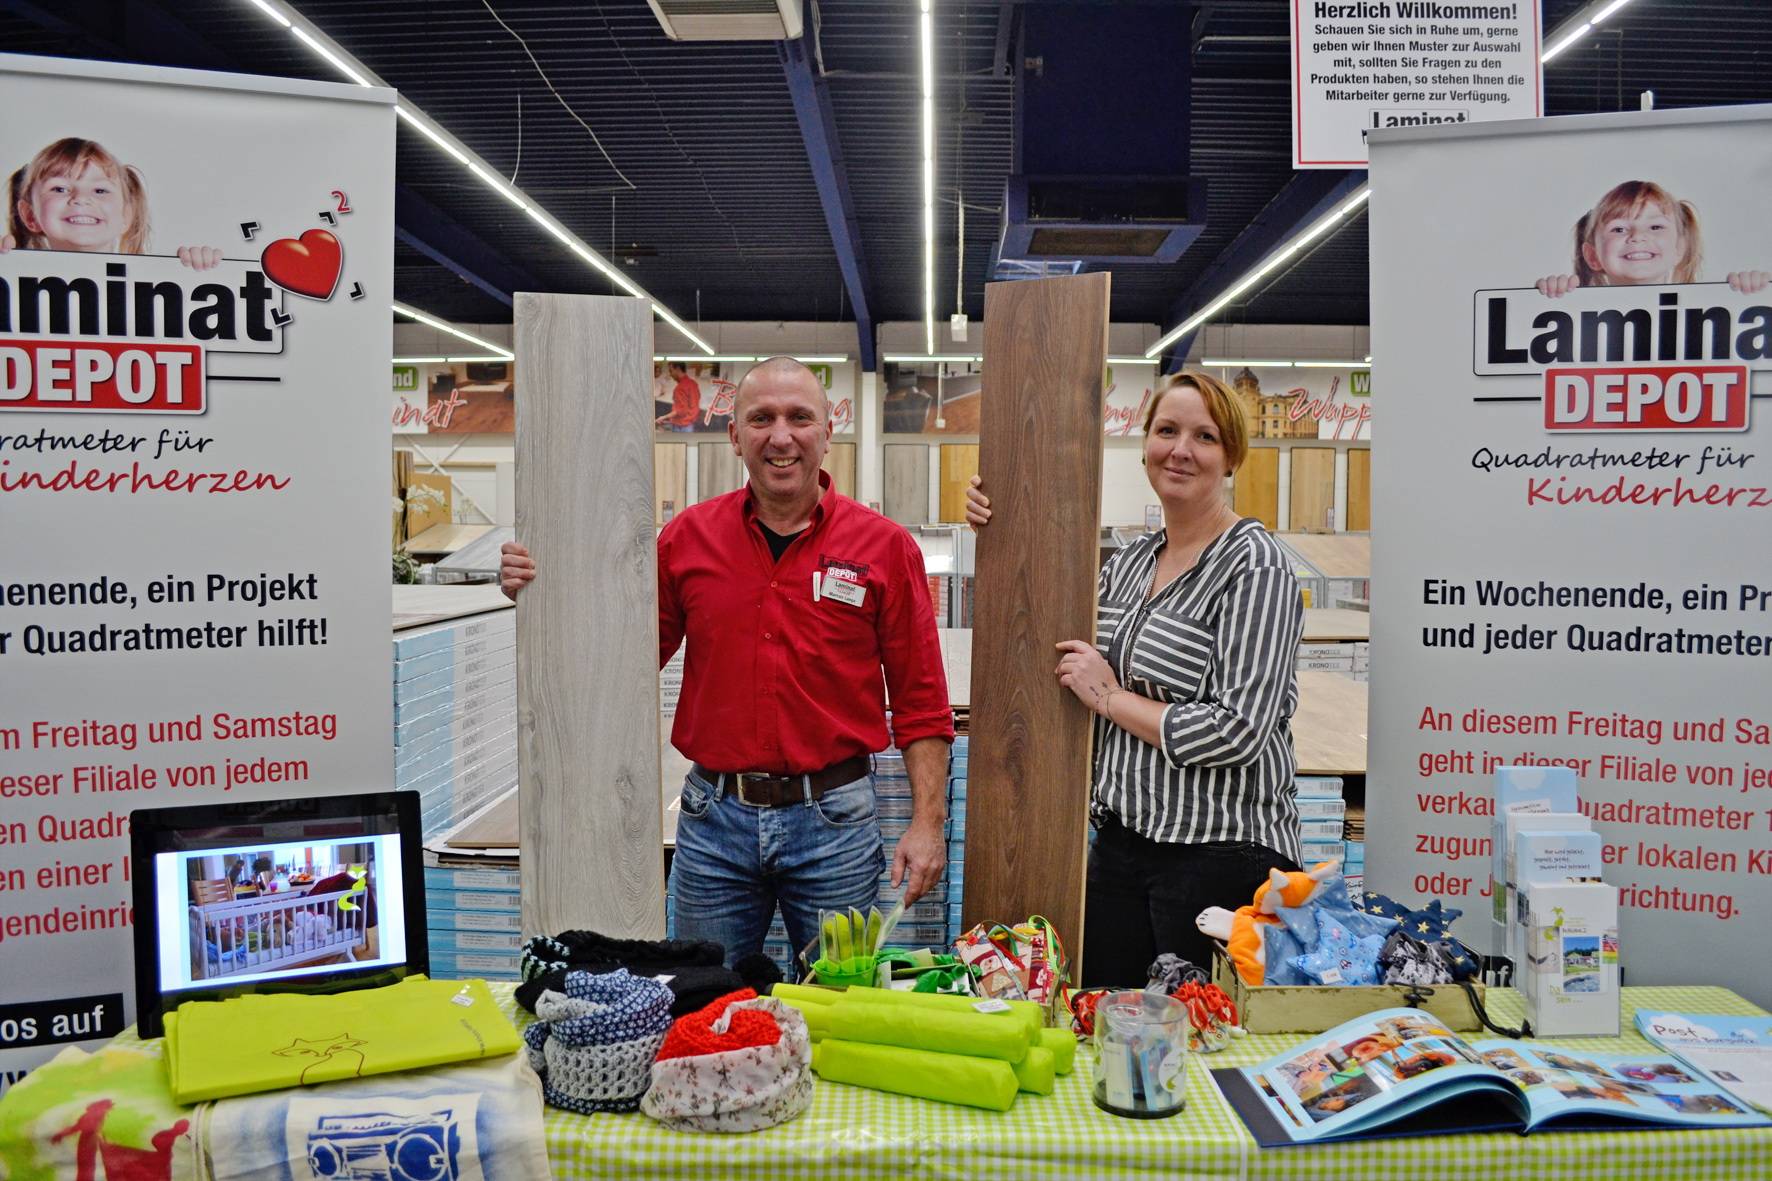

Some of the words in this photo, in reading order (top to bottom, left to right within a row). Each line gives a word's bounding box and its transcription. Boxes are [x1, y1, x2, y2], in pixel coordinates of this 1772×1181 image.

[1314, 1, 1390, 19] Herzlich
[1396, 2, 1518, 21] Willkommen!
[1313, 41, 1348, 53] geben
[1351, 41, 1370, 51] wir
[1373, 41, 1405, 52] Ihnen
[1409, 41, 1449, 52] Muster
[1452, 43, 1470, 53] zur
[1473, 42, 1521, 53] Auswahl
[1315, 24, 1364, 36] Schauen
[1368, 24, 1386, 36] Sie
[1389, 25, 1413, 36] sich
[1416, 25, 1427, 36] in
[1430, 25, 1459, 36] Ruhe
[1462, 27, 1484, 38] um,
[1486, 27, 1518, 38] gerne
[1311, 74, 1370, 85] Produkten
[1373, 74, 1412, 87] haben,
[1415, 76, 1428, 86] so
[1431, 75, 1469, 86] stehen
[1473, 75, 1504, 86] Ihnen
[1507, 75, 1525, 86] die
[1333, 57, 1356, 70] mit,
[1359, 57, 1398, 69] sollten
[1401, 58, 1419, 69] Sie
[1422, 58, 1461, 70] Fragen
[1464, 60, 1478, 70] zu
[1481, 59, 1502, 69] den
[1325, 90, 1389, 102] Mitarbeiter
[1393, 92, 1426, 104] gerne
[1428, 92, 1447, 102] zur
[1450, 91, 1511, 104] Verfügung.
[331, 190, 351, 212] 2
[0, 263, 272, 341] minat
[0, 346, 192, 404] DEPOT
[1554, 372, 1738, 424] DEPOT
[154, 428, 213, 459] für
[1471, 446, 1690, 473] Quadratmeter
[1696, 446, 1755, 474] für
[0, 460, 291, 494] inderherzen
[0, 575, 137, 609] enende,
[147, 574, 195, 603] ein
[207, 573, 318, 607] Projekt
[1423, 579, 1466, 606] Ein
[1476, 580, 1672, 614] Wochenende,
[1682, 584, 1728, 611] ein
[23, 621, 248, 656] Quadratmeter
[257, 618, 328, 647] hilft!
[1422, 623, 1475, 649] und
[1483, 622, 1558, 654] jeder
[1566, 624, 1772, 656] Quadratmeter
[32, 719, 137, 750] Freitag
[149, 715, 202, 743] und
[213, 711, 337, 741] Samstag
[1418, 706, 1453, 731] An
[1462, 708, 1557, 735] diesem
[1568, 711, 1662, 745] Freitag
[1673, 718, 1724, 743] und
[1735, 718, 1771, 745] Sa
[73, 764, 157, 794] Filiale
[166, 764, 216, 788] von
[224, 757, 309, 791] jedem
[1419, 749, 1474, 777] geht
[1483, 750, 1504, 775] in
[1601, 755, 1677, 783] Filiale
[1686, 765, 1733, 786] von
[38, 811, 132, 843] Quadr
[1577, 795, 1755, 831] uadratmeter
[1638, 842, 1737, 873] lokalen
[37, 861, 113, 889] einer
[1414, 872, 1473, 896] oder
[1618, 883, 1739, 920] richtung.
[0, 901, 134, 943] endeinri
[52, 1004, 104, 1037] auf
